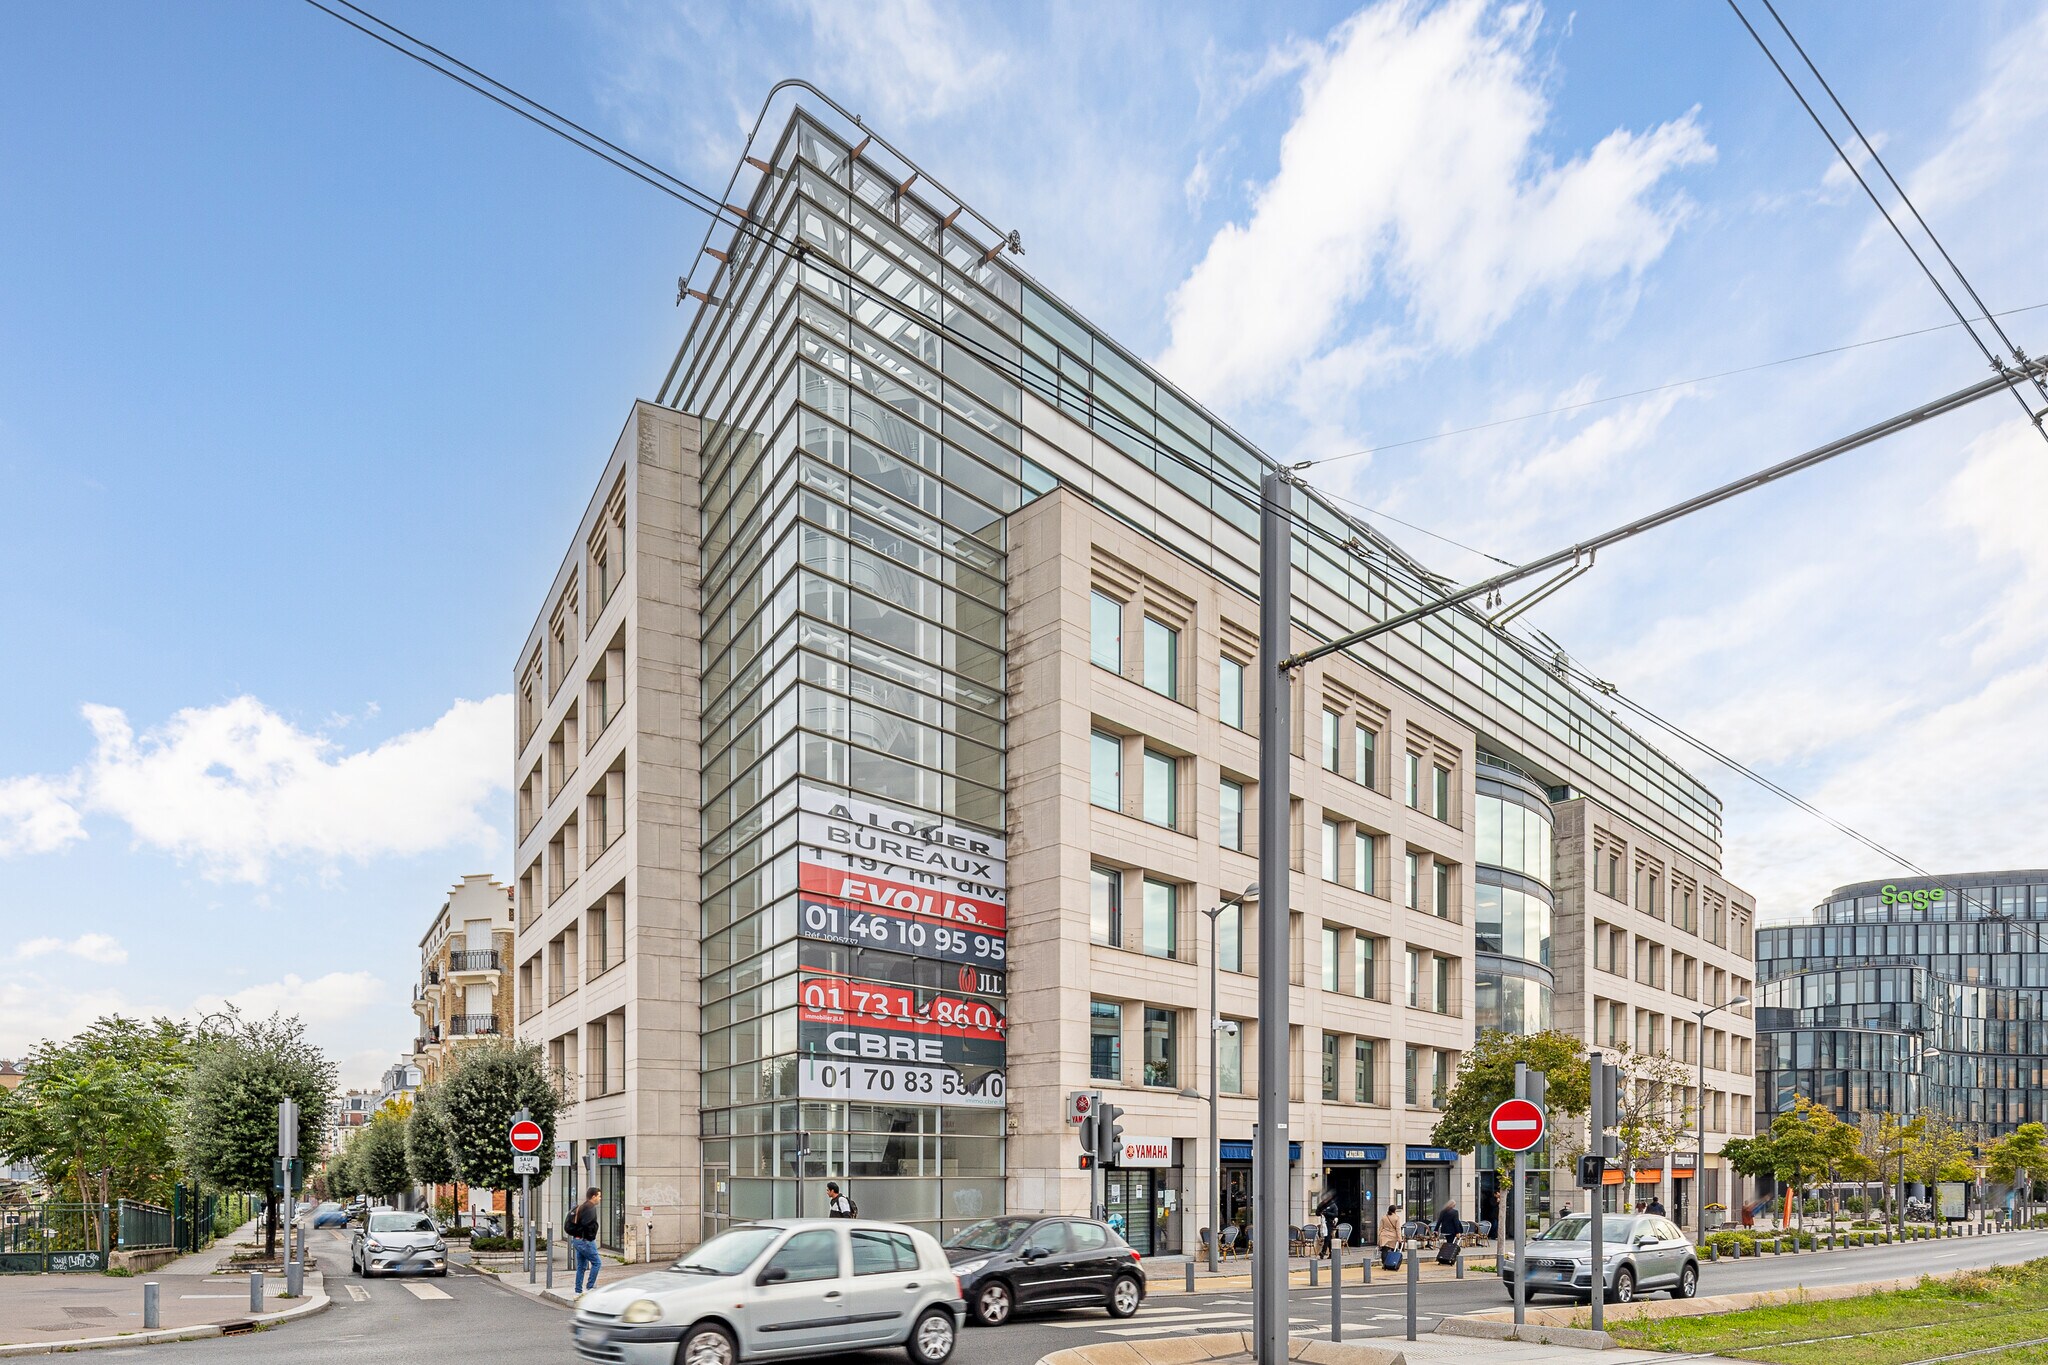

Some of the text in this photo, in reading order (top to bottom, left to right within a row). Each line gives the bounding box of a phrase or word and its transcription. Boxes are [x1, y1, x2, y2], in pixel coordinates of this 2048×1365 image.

[828, 804, 853, 821] A
[827, 825, 992, 880] BUREAUX
[842, 854, 896, 875] 197
[957, 880, 1004, 901] div.
[1881, 884, 1945, 911] Sage
[805, 905, 1005, 960] 01 46 10 95 95
[805, 984, 845, 1015] 01
[852, 990, 891, 1020] 73
[937, 1001, 972, 1029] 86
[826, 1031, 944, 1064] CBRE
[821, 1065, 851, 1089] 01
[864, 1068, 895, 1091] 70
[904, 1071, 933, 1094] 83
[942, 1074, 969, 1096] 55
[1135, 1144, 1168, 1159] YAMAHA
